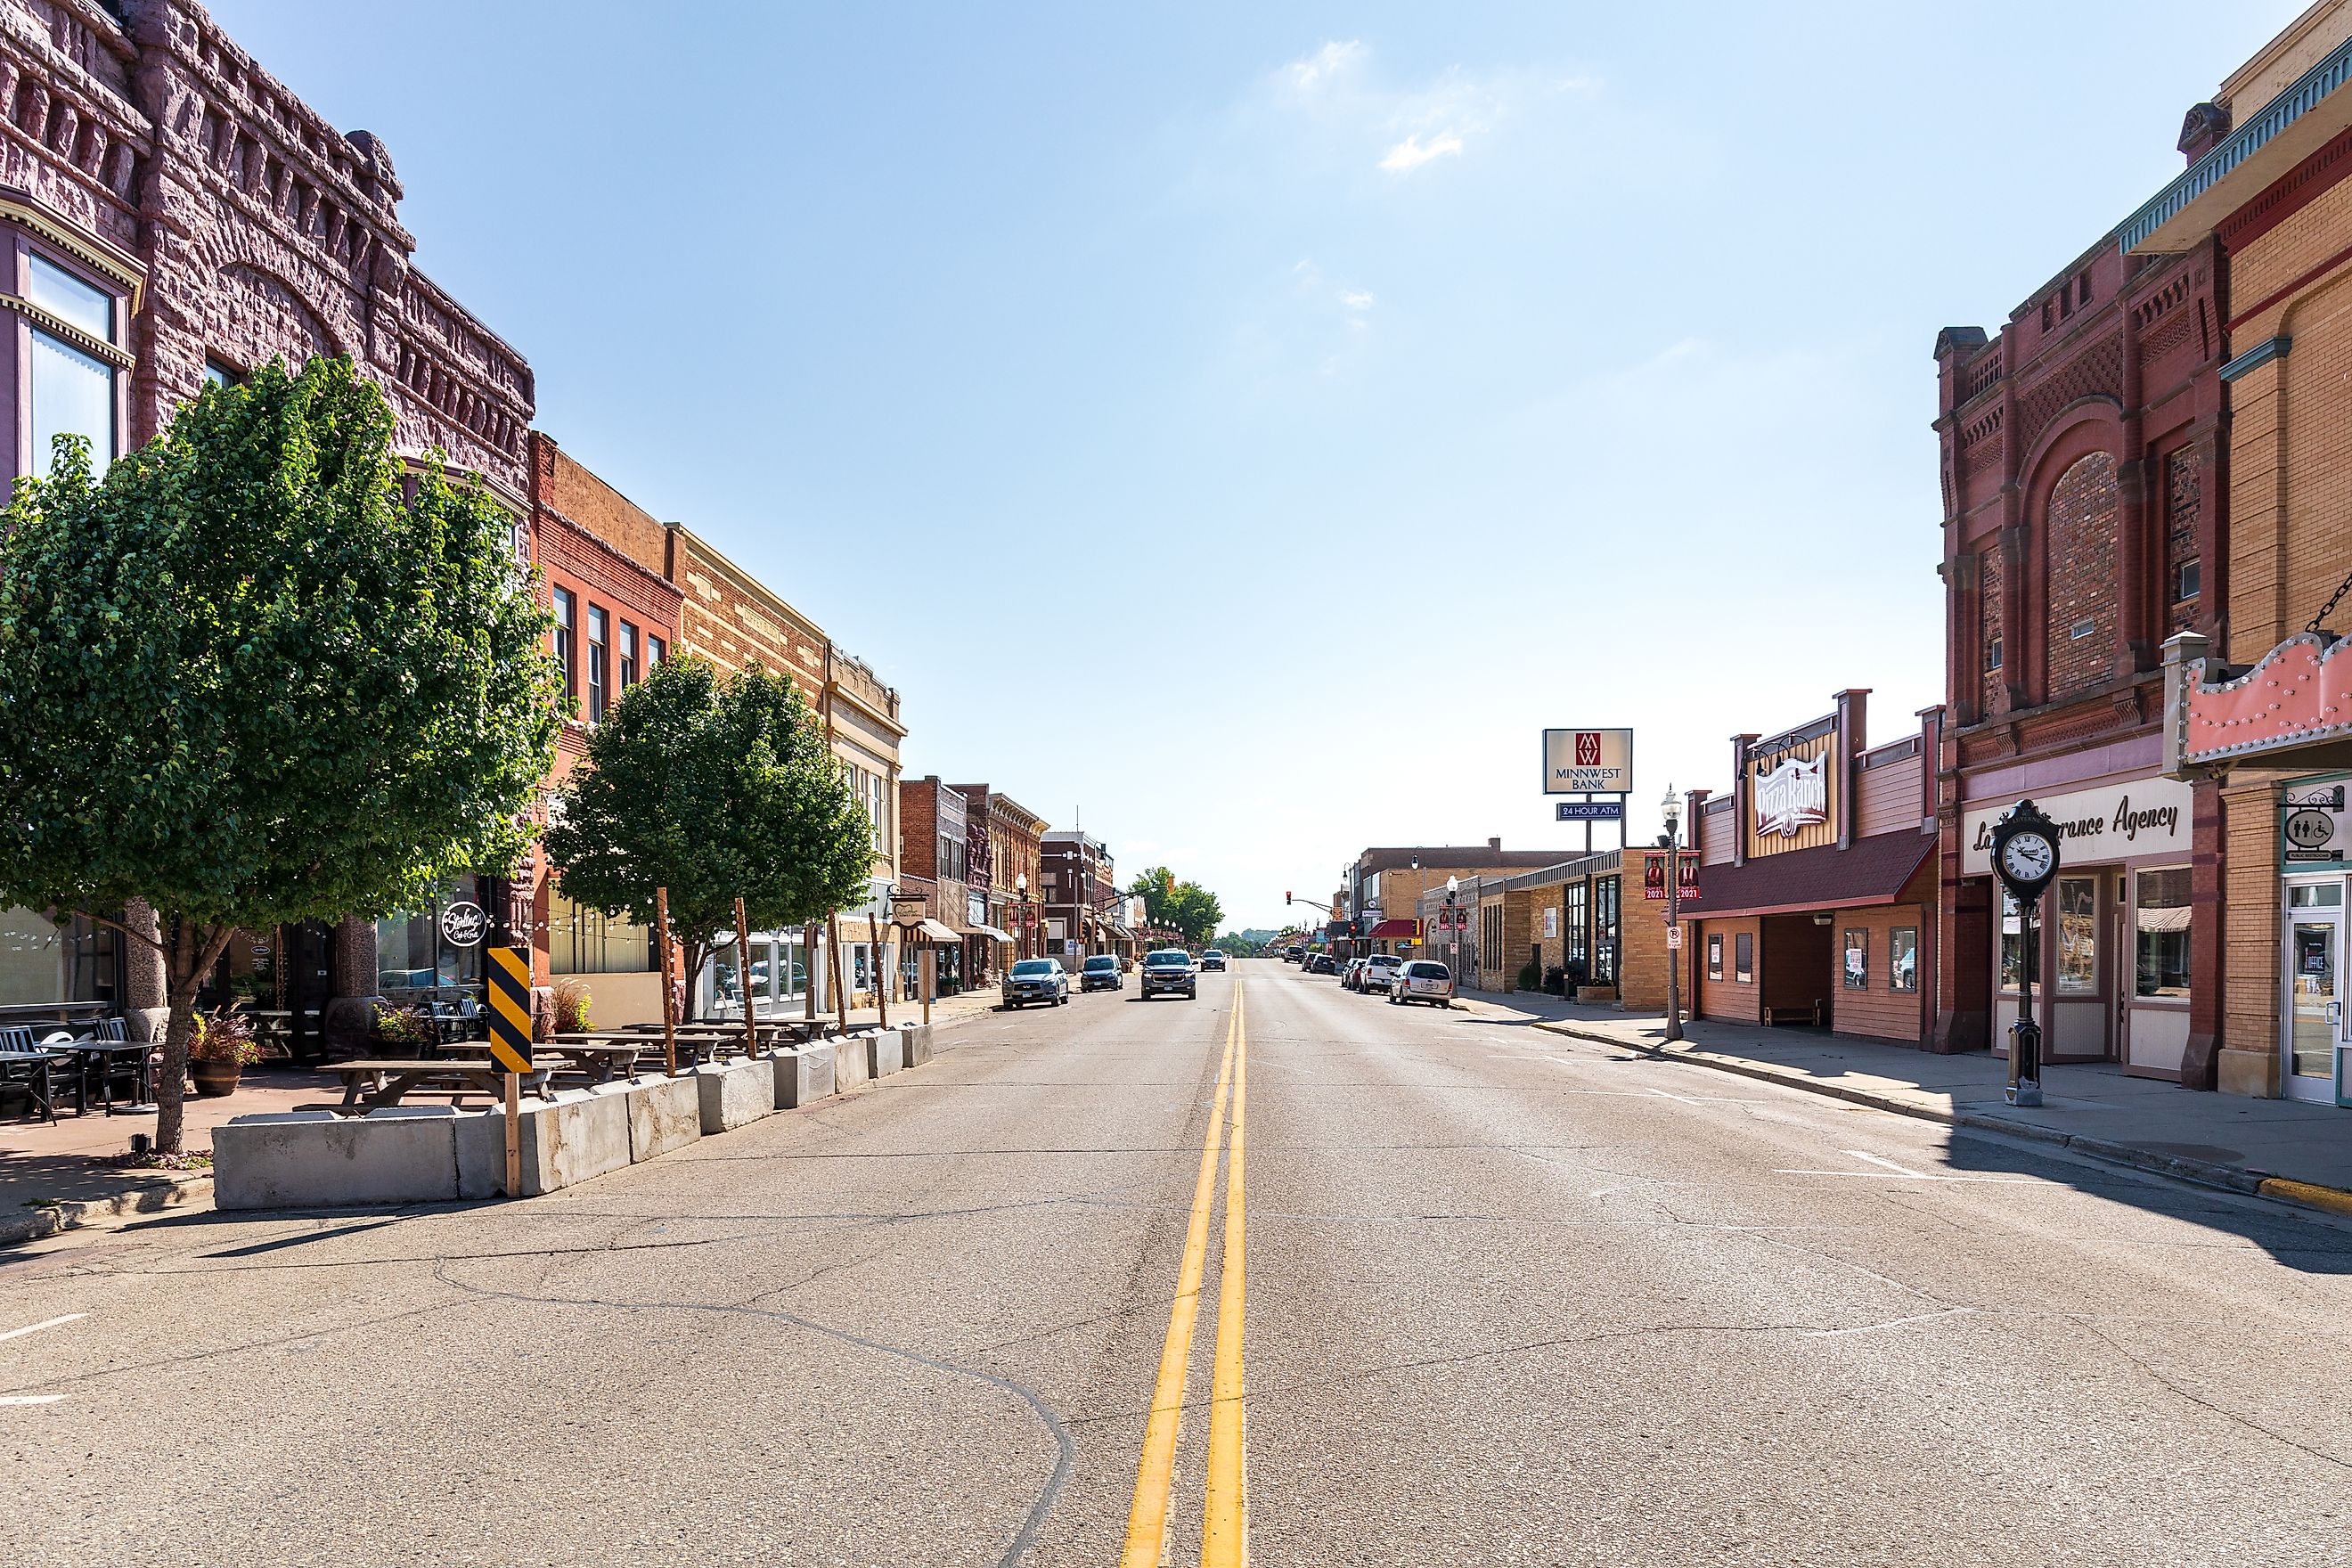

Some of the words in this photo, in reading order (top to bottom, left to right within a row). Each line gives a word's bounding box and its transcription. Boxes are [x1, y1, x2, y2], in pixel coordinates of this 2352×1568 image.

[1556, 768, 1621, 779] MINNWEST
[1572, 780, 1605, 789] BANK
[1757, 778, 1786, 829] Pizza
[1787, 764, 1825, 813] Ranch
[1563, 807, 1572, 815] 24
[1574, 807, 1598, 815] HOUR
[2112, 795, 2178, 841] Agency
[1646, 890, 1663, 899] 2021
[1680, 889, 1697, 898] 2021
[2308, 956, 2323, 969] OFFICE
